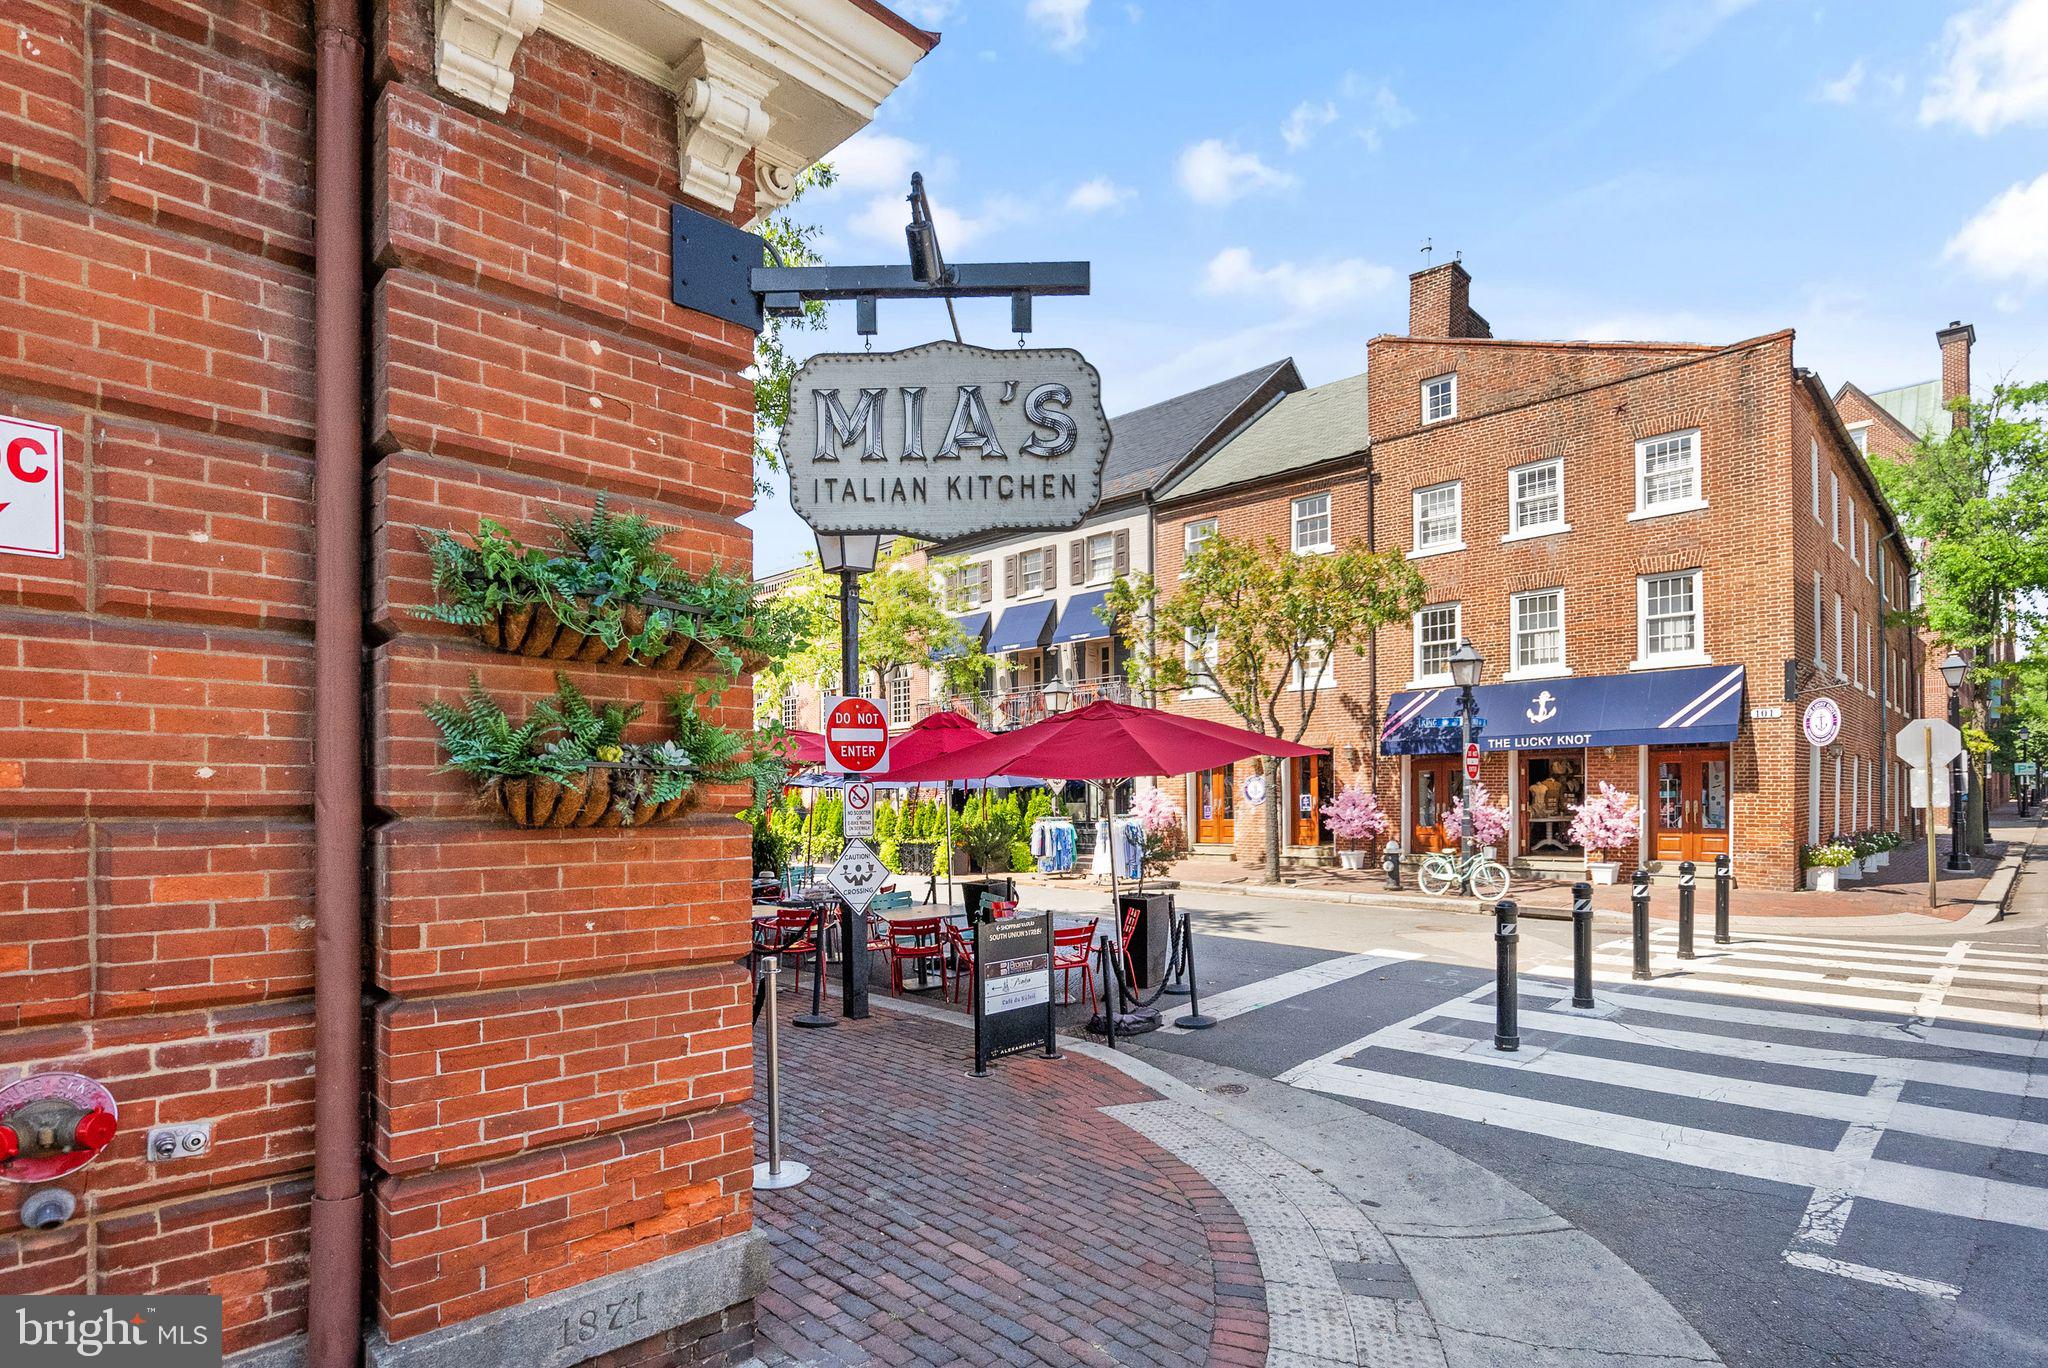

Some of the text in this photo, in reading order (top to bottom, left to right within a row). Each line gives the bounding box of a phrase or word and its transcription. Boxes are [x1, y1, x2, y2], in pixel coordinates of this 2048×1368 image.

[812, 380, 1078, 463] MIA'S
[0, 436, 49, 484] C
[813, 473, 1077, 503] ITALIAN KITCHEN
[835, 712, 879, 725] DO NOT
[1488, 734, 1592, 749] THE LUCKY KNOT
[840, 745, 876, 758] ENTER
[844, 853, 871, 861] CAUTION!
[843, 886, 874, 896] CROSSING
[989, 928, 1042, 942] SOUTH UNION STREET
[1000, 1042, 1036, 1054] ALEXANDRIA
[556, 1290, 648, 1351] 1871
